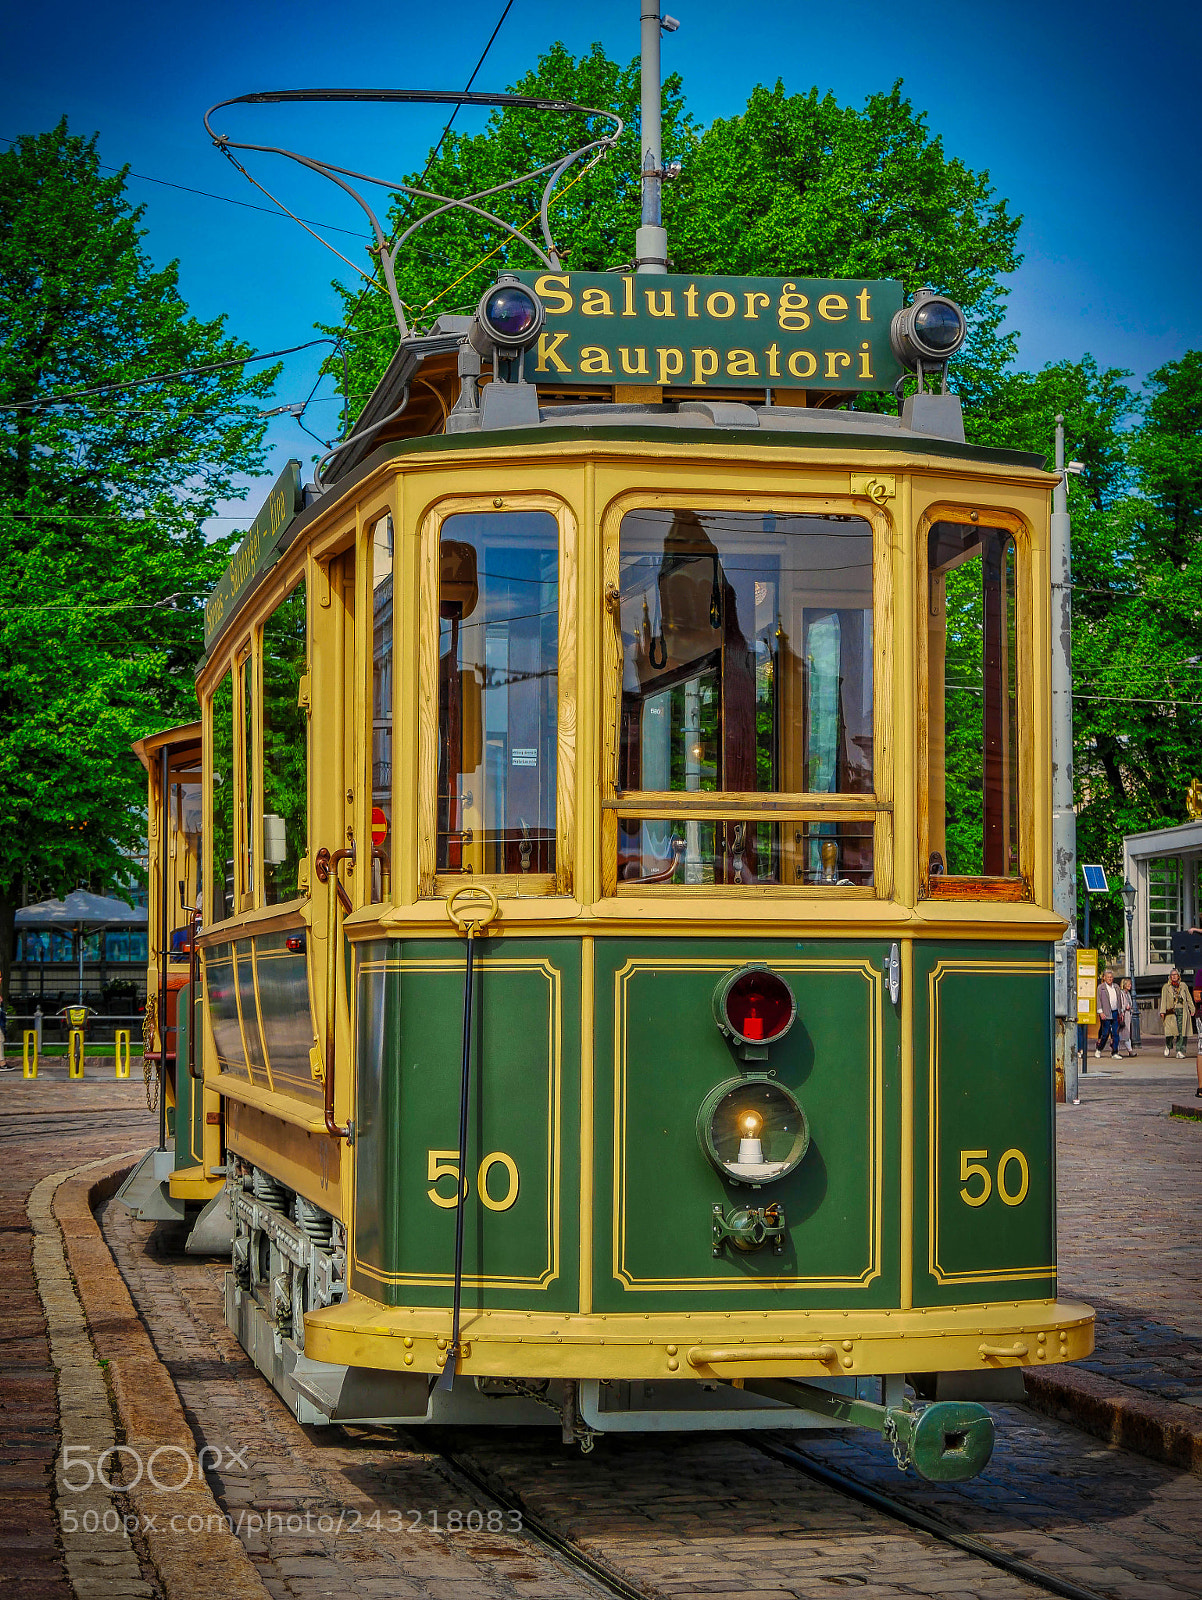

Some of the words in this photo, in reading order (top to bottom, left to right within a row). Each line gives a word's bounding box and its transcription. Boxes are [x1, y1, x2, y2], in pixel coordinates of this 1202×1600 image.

[534, 274, 874, 332] Salutorget
[534, 332, 875, 385] Kauppatori
[230, 522, 261, 597] Salutorget
[427, 1150, 520, 1212] 50
[959, 1148, 1029, 1208] 50
